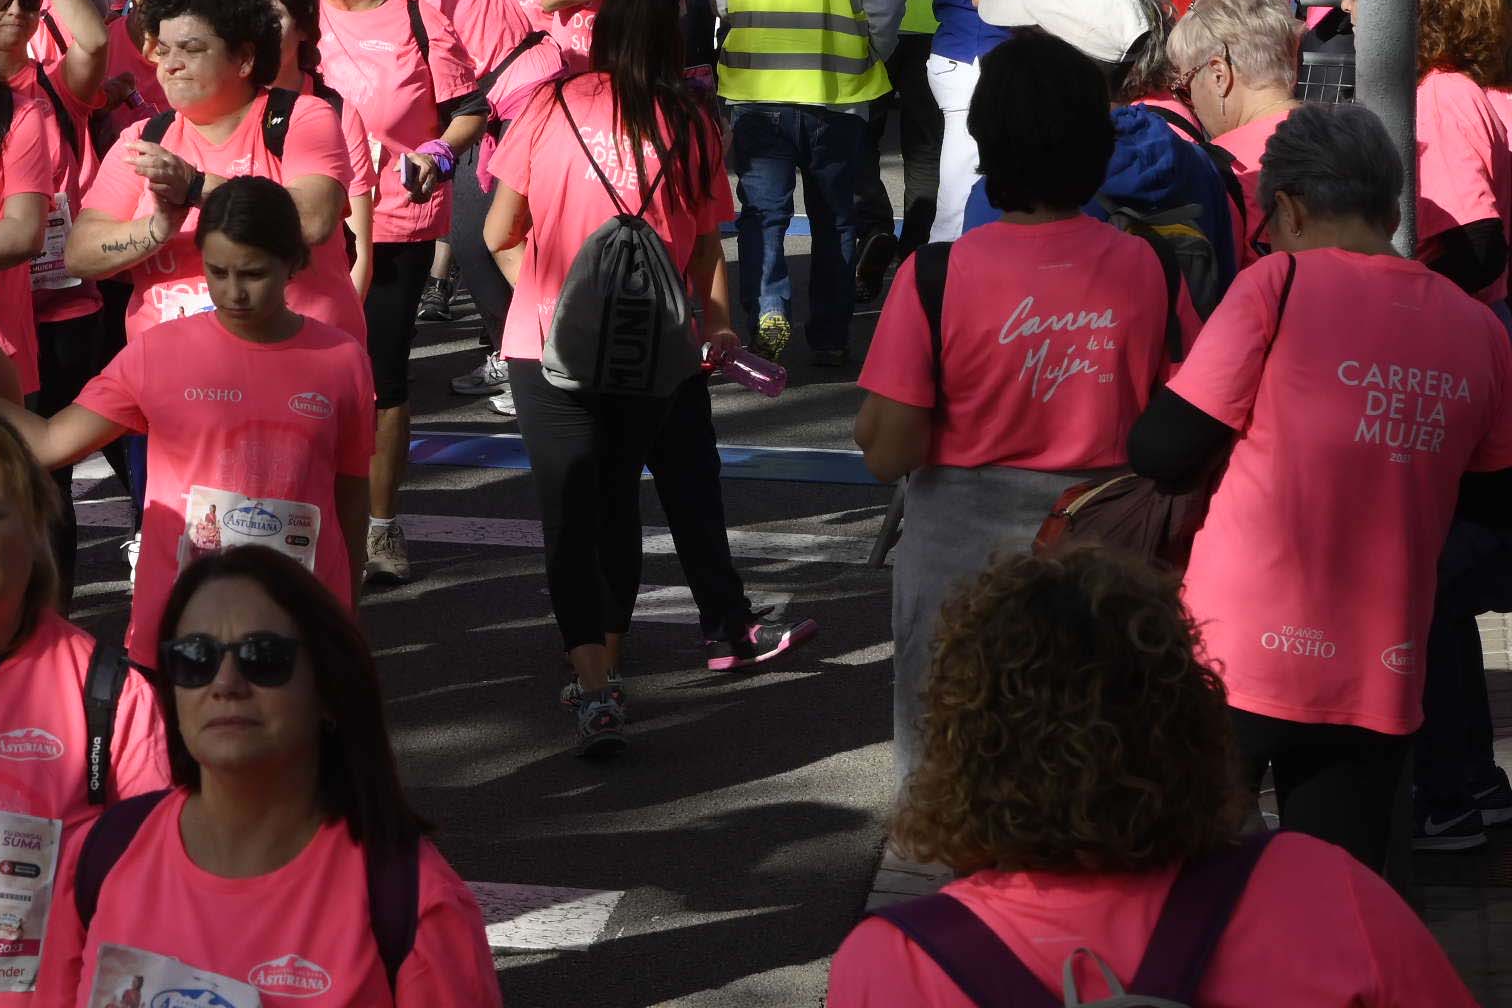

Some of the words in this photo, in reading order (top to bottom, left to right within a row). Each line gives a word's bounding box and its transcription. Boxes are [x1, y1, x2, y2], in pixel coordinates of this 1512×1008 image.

[1018, 338, 1099, 403] Mujer
[1338, 360, 1472, 403] CARRERA
[184, 387, 243, 403] OYSHO
[1366, 391, 1406, 420] DE
[1416, 397, 1446, 426] LA
[1354, 419, 1446, 453] MUJER
[227, 514, 278, 533] ASTURIANA
[1281, 624, 1294, 636] 10
[1261, 632, 1336, 659] OYSHO
[90, 736, 102, 791] Quechua
[2, 838, 42, 849] SUMA
[257, 970, 325, 990] ASTURIANA
